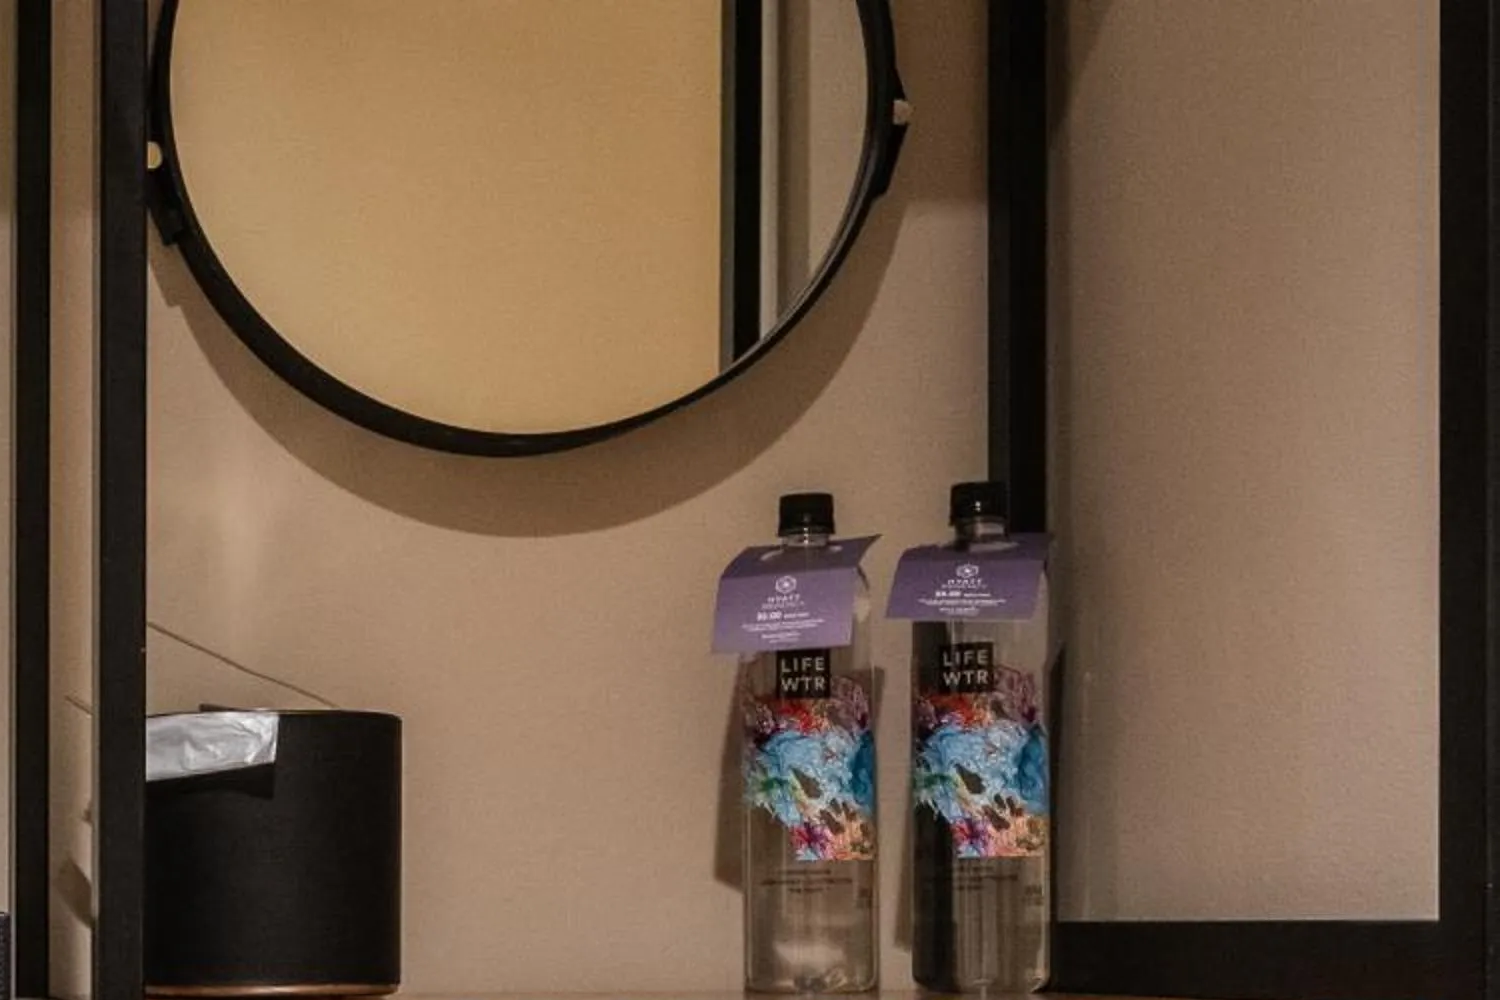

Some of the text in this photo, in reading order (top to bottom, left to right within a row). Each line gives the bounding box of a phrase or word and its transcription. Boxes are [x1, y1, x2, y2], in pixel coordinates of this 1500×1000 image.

[780, 656, 826, 673] LIFE
[942, 650, 990, 667] LIFE
[780, 676, 826, 692] WTR
[942, 670, 990, 687] WTR
